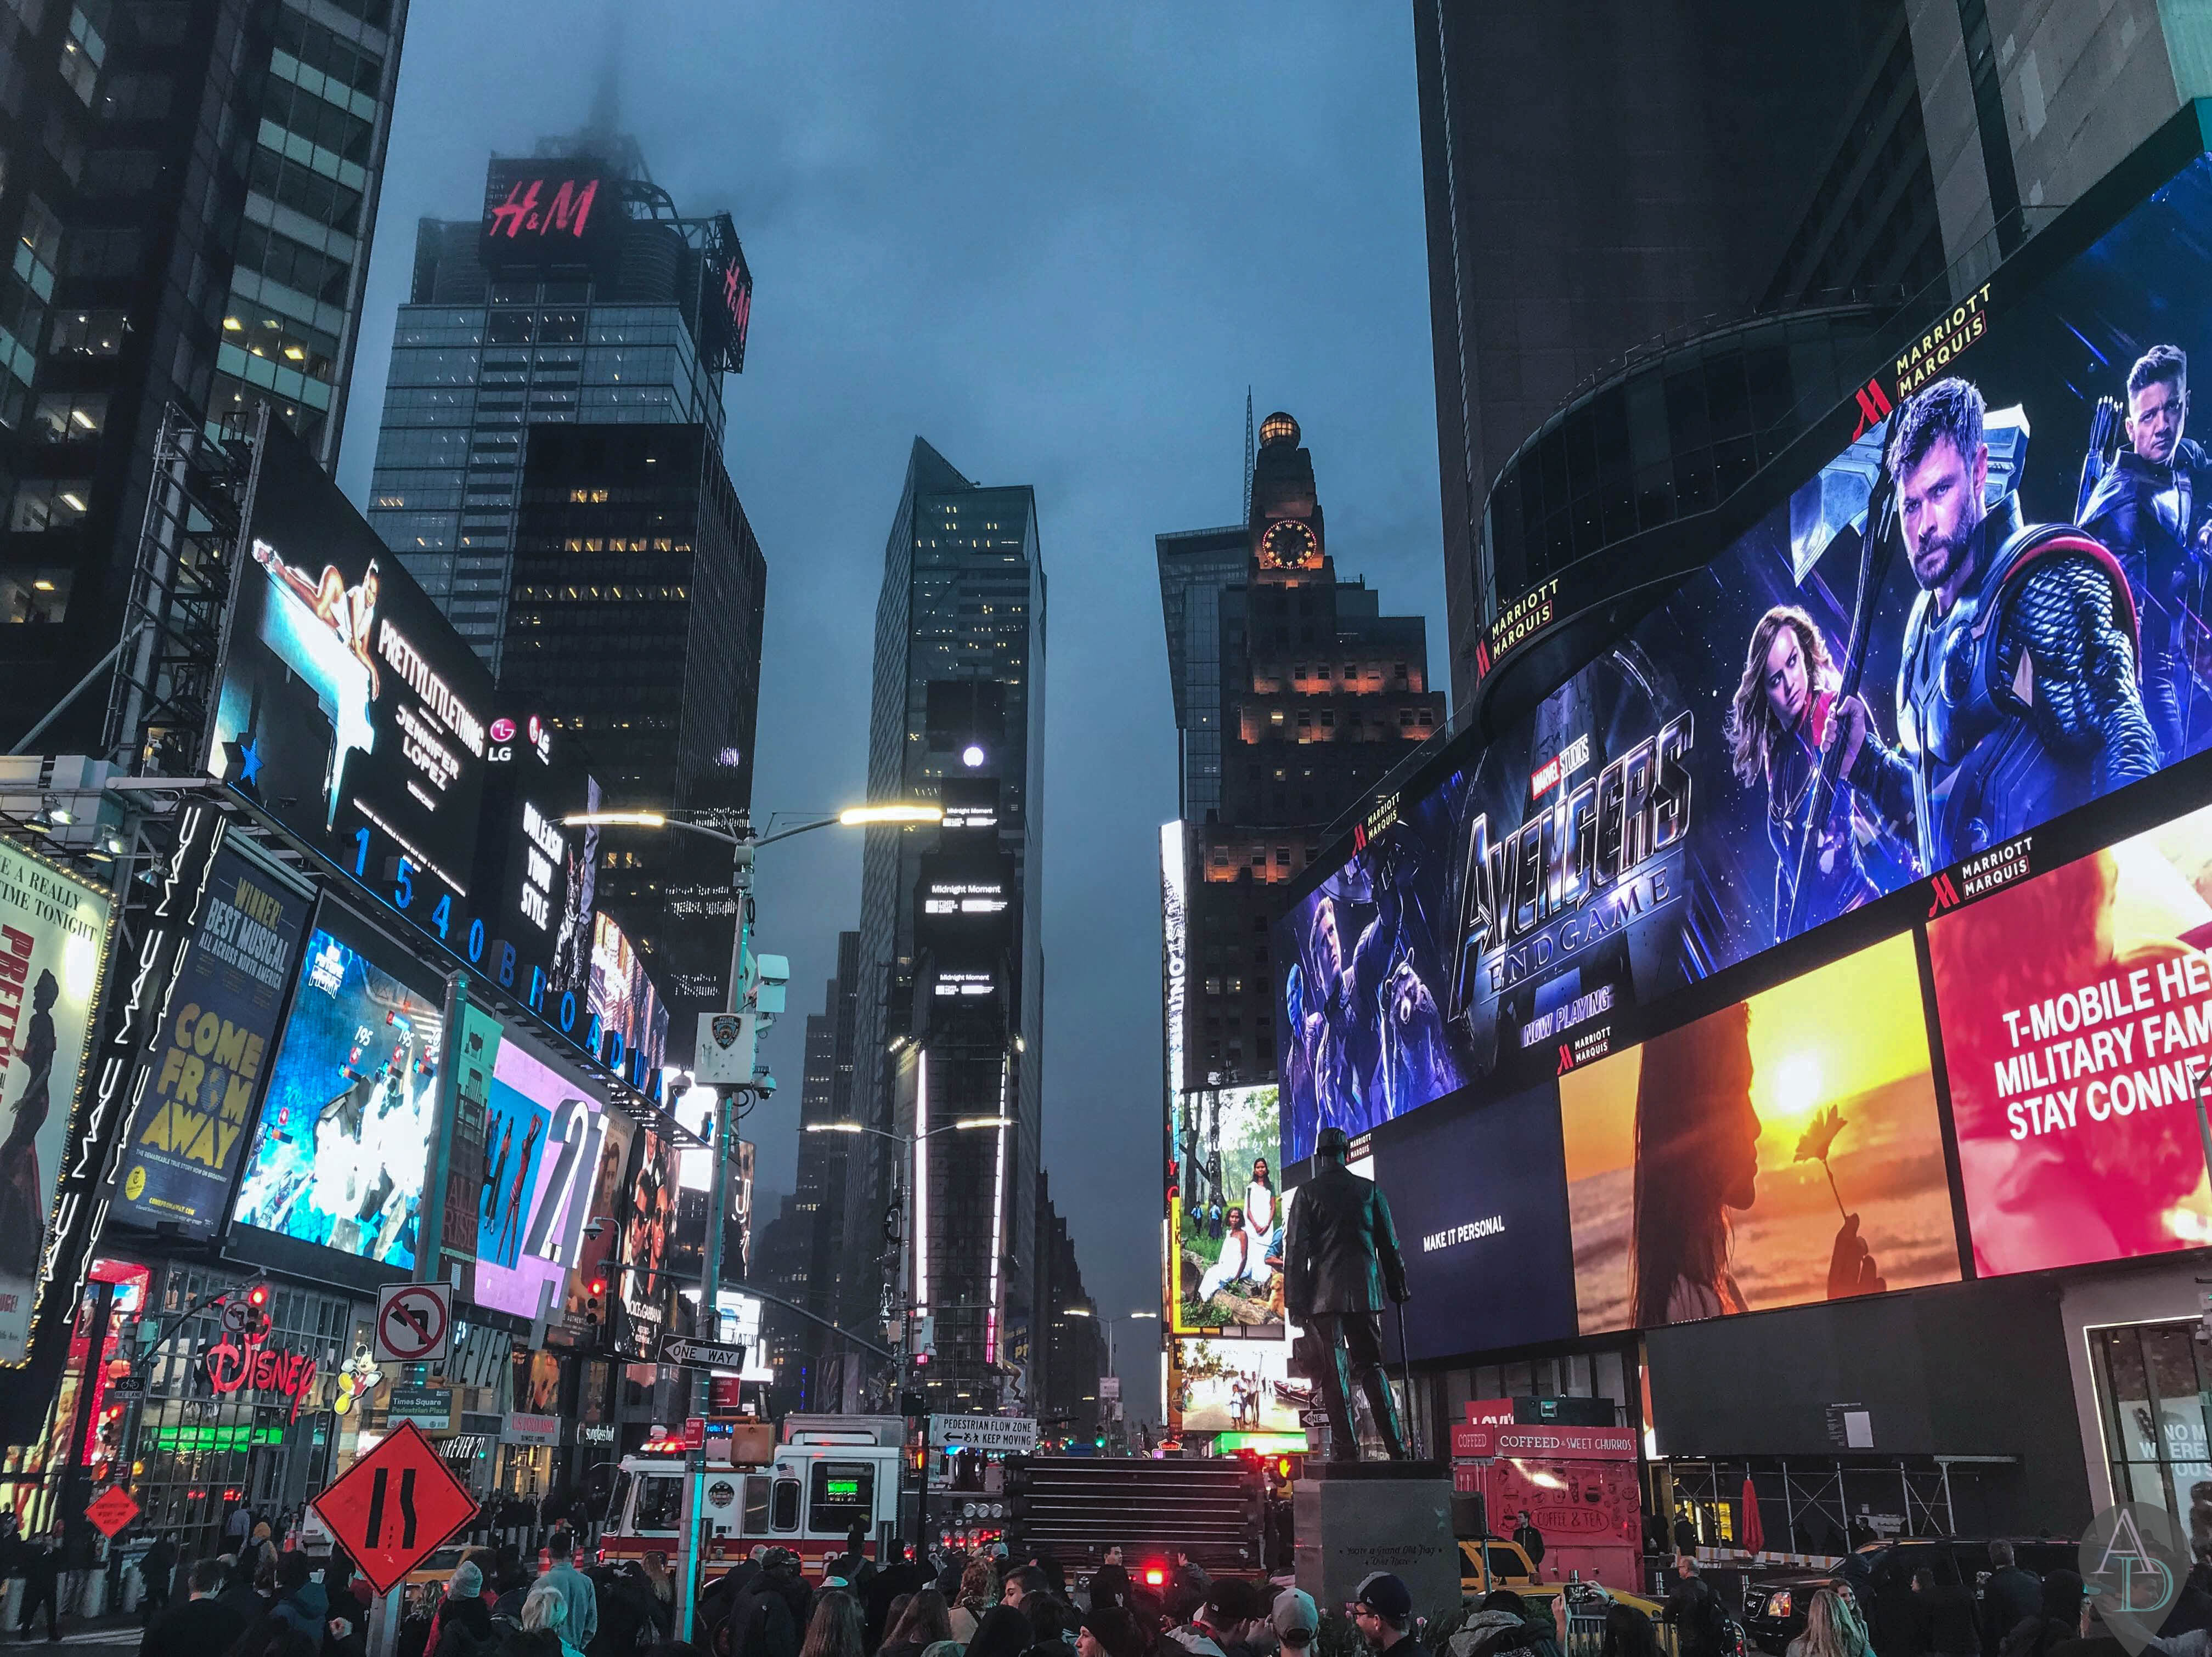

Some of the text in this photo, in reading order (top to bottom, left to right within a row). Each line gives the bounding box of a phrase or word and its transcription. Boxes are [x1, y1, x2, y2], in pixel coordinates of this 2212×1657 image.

[489, 179, 600, 239] H&M
[1897, 283, 1991, 375] MARRIOTT
[1899, 317, 1983, 398] MARQUIS
[1492, 579, 1559, 640] MARRIOTT
[1493, 606, 1550, 660] MARQUIS
[378, 618, 484, 757] PRETTYLITTLETHING
[396, 705, 459, 780] JENNIFER
[403, 736, 448, 791] LOPEZ
[488, 747, 511, 762] LG
[1532, 738, 1589, 792] MARVEL STUDIOS
[1368, 791, 1400, 827] MARRIOTT
[1368, 810, 1397, 840] MARQUIS
[523, 801, 563, 866] UNLEASH
[1448, 710, 1695, 1023] AVENGERS
[1962, 836, 2033, 880] MARRIOTT
[1965, 860, 2028, 898] MARQUIS
[16, 865, 24, 883] A
[31, 871, 82, 912] REALLY
[234, 876, 284, 931] WINNER!
[521, 882, 550, 931] STYLE
[932, 885, 1001, 895] Midnight Moment
[35, 893, 97, 942] TONIGHT
[204, 897, 241, 943] BEST
[237, 917, 288, 974] MUSICAL
[1488, 866, 1671, 994] ENDGAME
[199, 932, 212, 952] ALL
[211, 938, 238, 965] ACROSS
[237, 953, 258, 977] NORTH
[256, 964, 283, 991] AMERICA
[1523, 986, 1610, 1047] NOW PLAYING
[2002, 947, 2212, 1048] T-MOBILE HE
[175, 1003, 265, 1079] COME
[354, 1025, 373, 1047] 195
[398, 1027, 415, 1048] 195
[1575, 1026, 1611, 1050] MARRIOTT
[1576, 1042, 1608, 1063] MARQUIS
[1994, 1021, 2135, 1098] MILITARY
[2007, 1054, 2212, 1141] STAY CONNE
[140, 1099, 240, 1169] AWAY
[1350, 1132, 1372, 1149] MARRIOTT
[1350, 1145, 1370, 1159] MARQUIS
[144, 1150, 170, 1165] REMARKABLE
[171, 1158, 181, 1168] TRUE
[180, 1161, 193, 1172] STORY
[1423, 1215, 1505, 1253] MAKE IT PERSONAL
[673, 1345, 734, 1365] ONE WAY
[415, 1398, 442, 1407] Square
[585, 1424, 615, 1445] sunglass hut
[944, 1418, 1032, 1433] PEDESTRIAN FLOW ZONE
[982, 1433, 1031, 1446] KEEP MOVING
[1458, 1434, 1487, 1448] COFFEED
[1500, 1435, 1560, 1449] COFFEED
[1566, 1437, 1592, 1450] SWEET
[1595, 1438, 1632, 1451] CHURROS
[2164, 1424, 2188, 1441] NO
[2139, 1442, 2205, 1459] WERE
[1537, 1512, 1602, 1528] COFFEE & TEA
